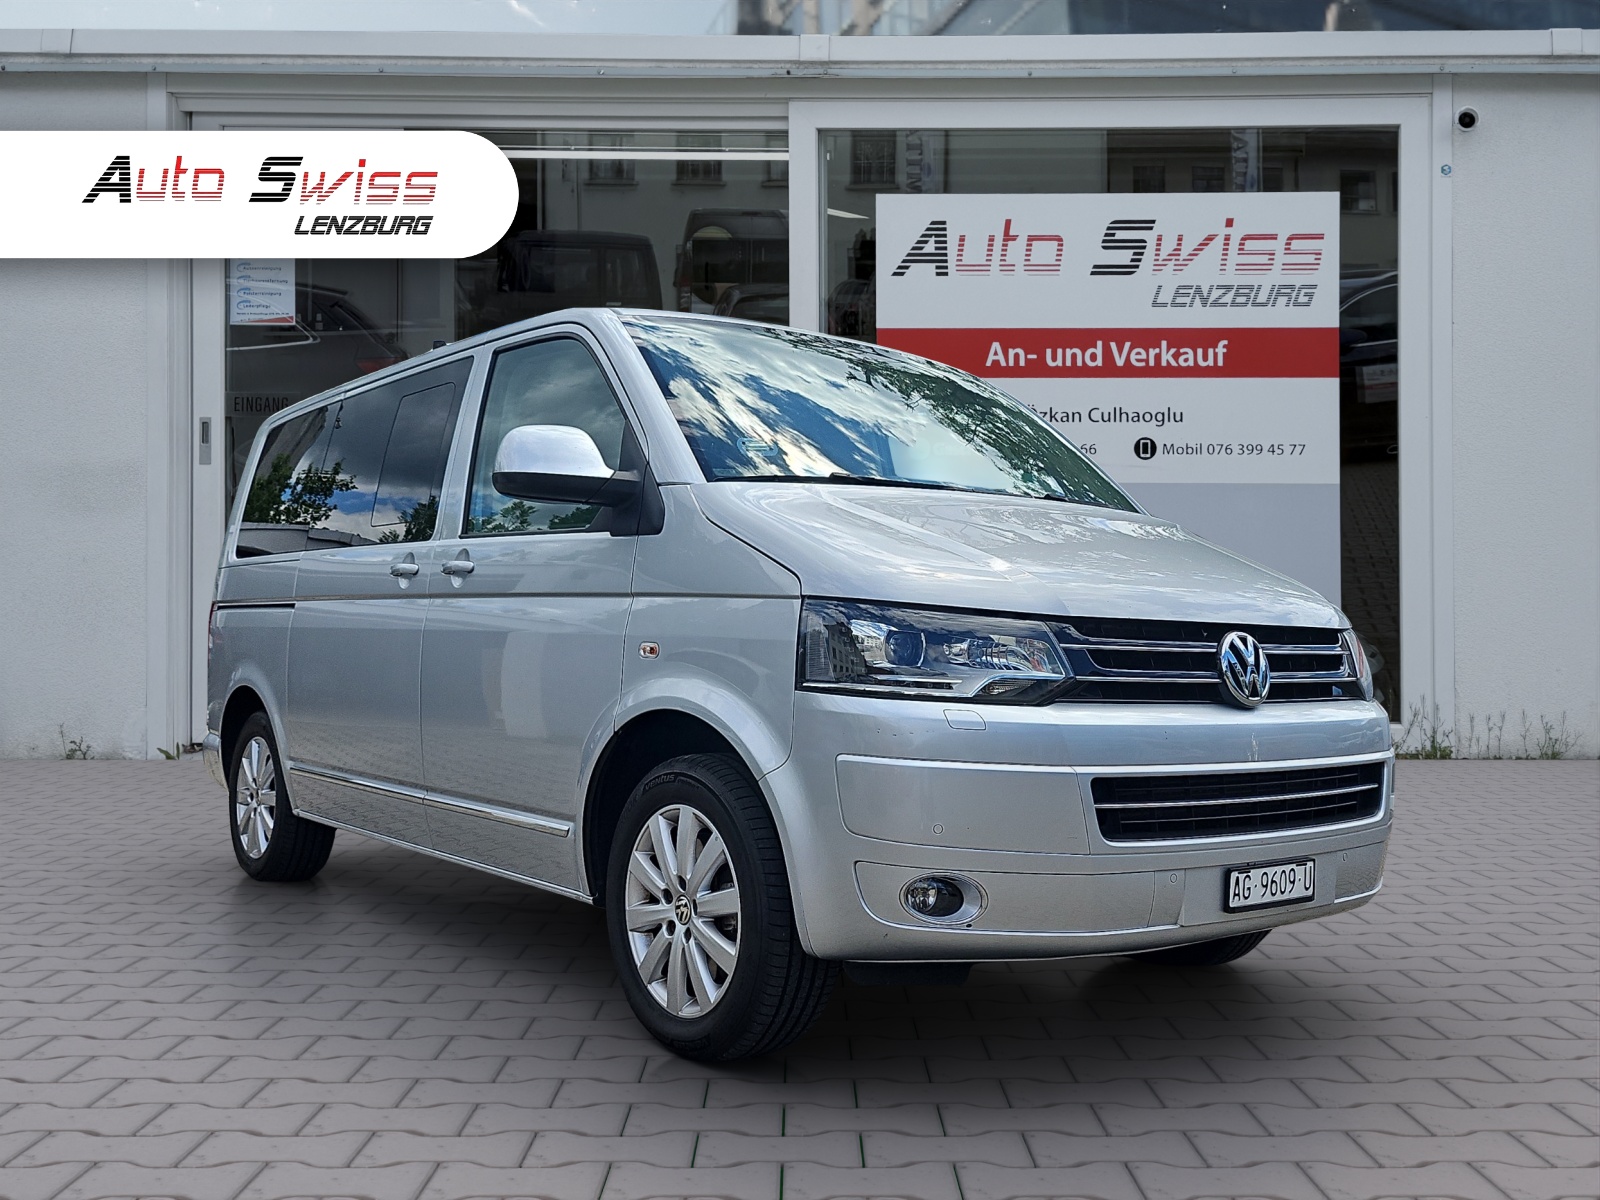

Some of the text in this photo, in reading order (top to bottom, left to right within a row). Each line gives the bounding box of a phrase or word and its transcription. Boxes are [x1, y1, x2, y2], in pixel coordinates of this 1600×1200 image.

[891, 218, 1325, 276] Auto Swiss
[1151, 284, 1318, 308] LENZBURG
[985, 340, 1229, 367] An- und Verkauf
[233, 396, 289, 412] EINGANG
[1088, 407, 1184, 427] Culhaoglu
[1162, 442, 1306, 455] Mobil 076 399 45 77
